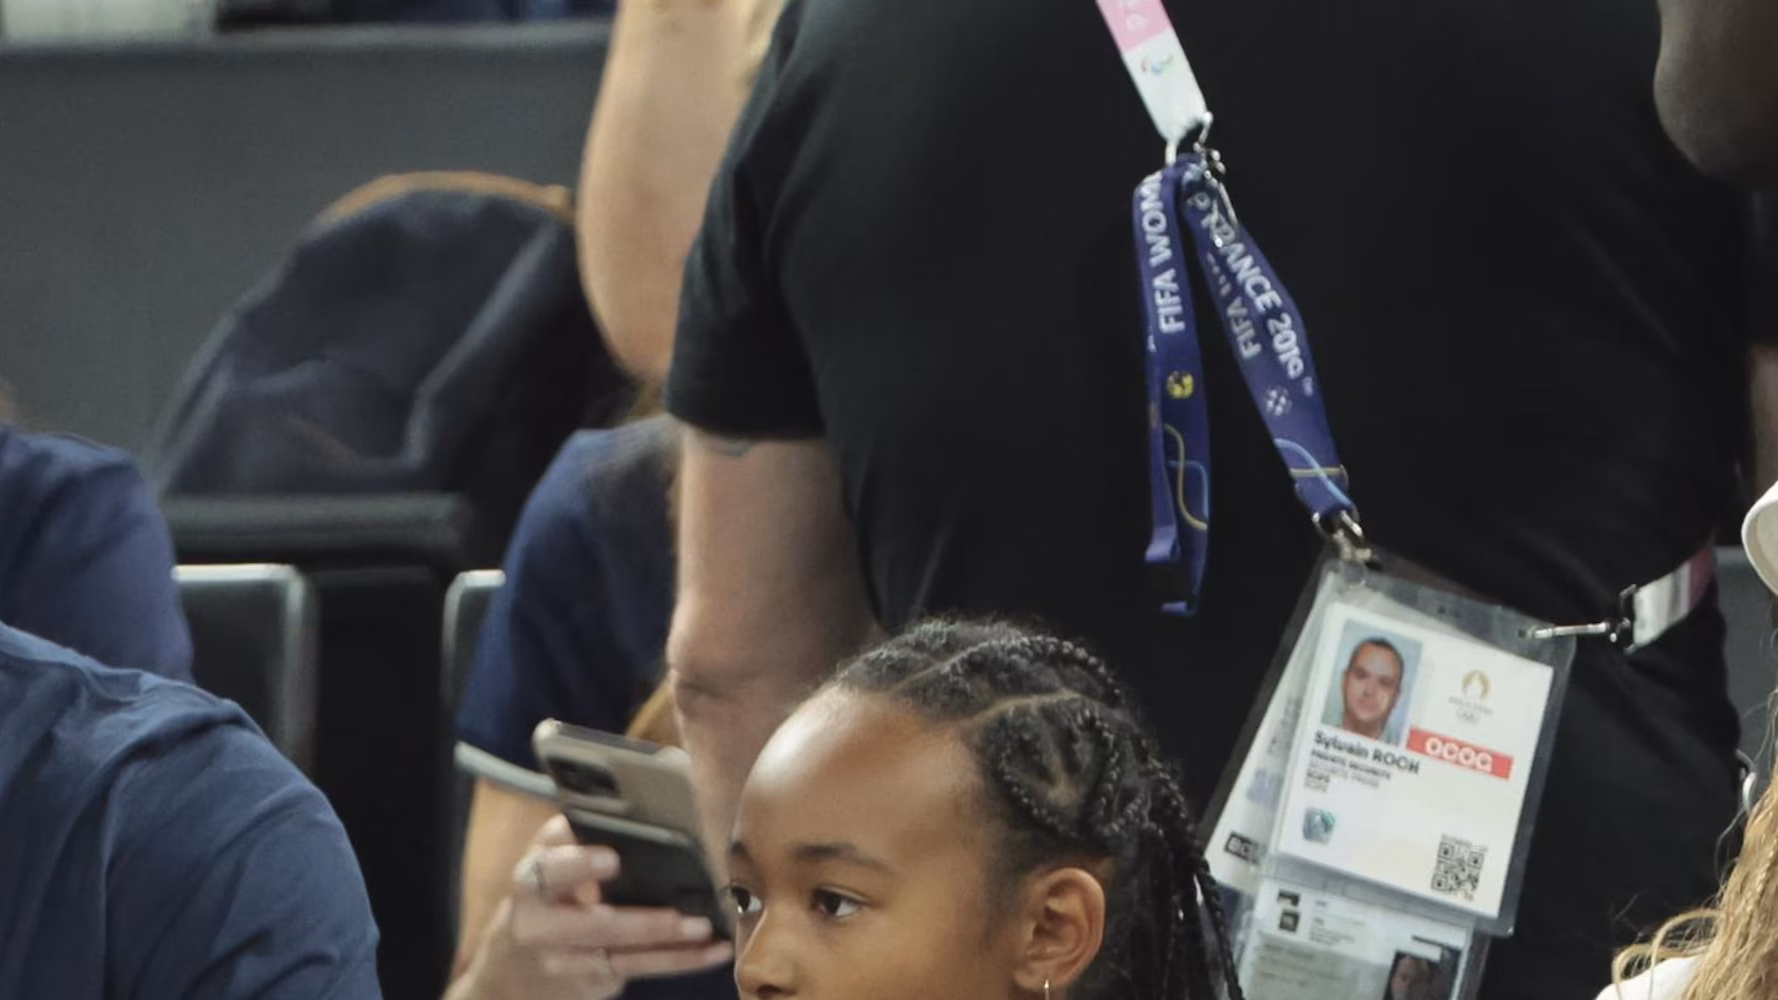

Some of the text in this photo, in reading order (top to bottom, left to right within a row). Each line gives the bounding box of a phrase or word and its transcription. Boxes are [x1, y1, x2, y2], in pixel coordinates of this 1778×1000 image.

[1152, 268, 1185, 334] FIFA
[1226, 296, 1262, 360] FIFA
[1266, 312, 1304, 380] 2019
[1314, 730, 1369, 759] Sylvain
[1372, 747, 1421, 775] ROCH
